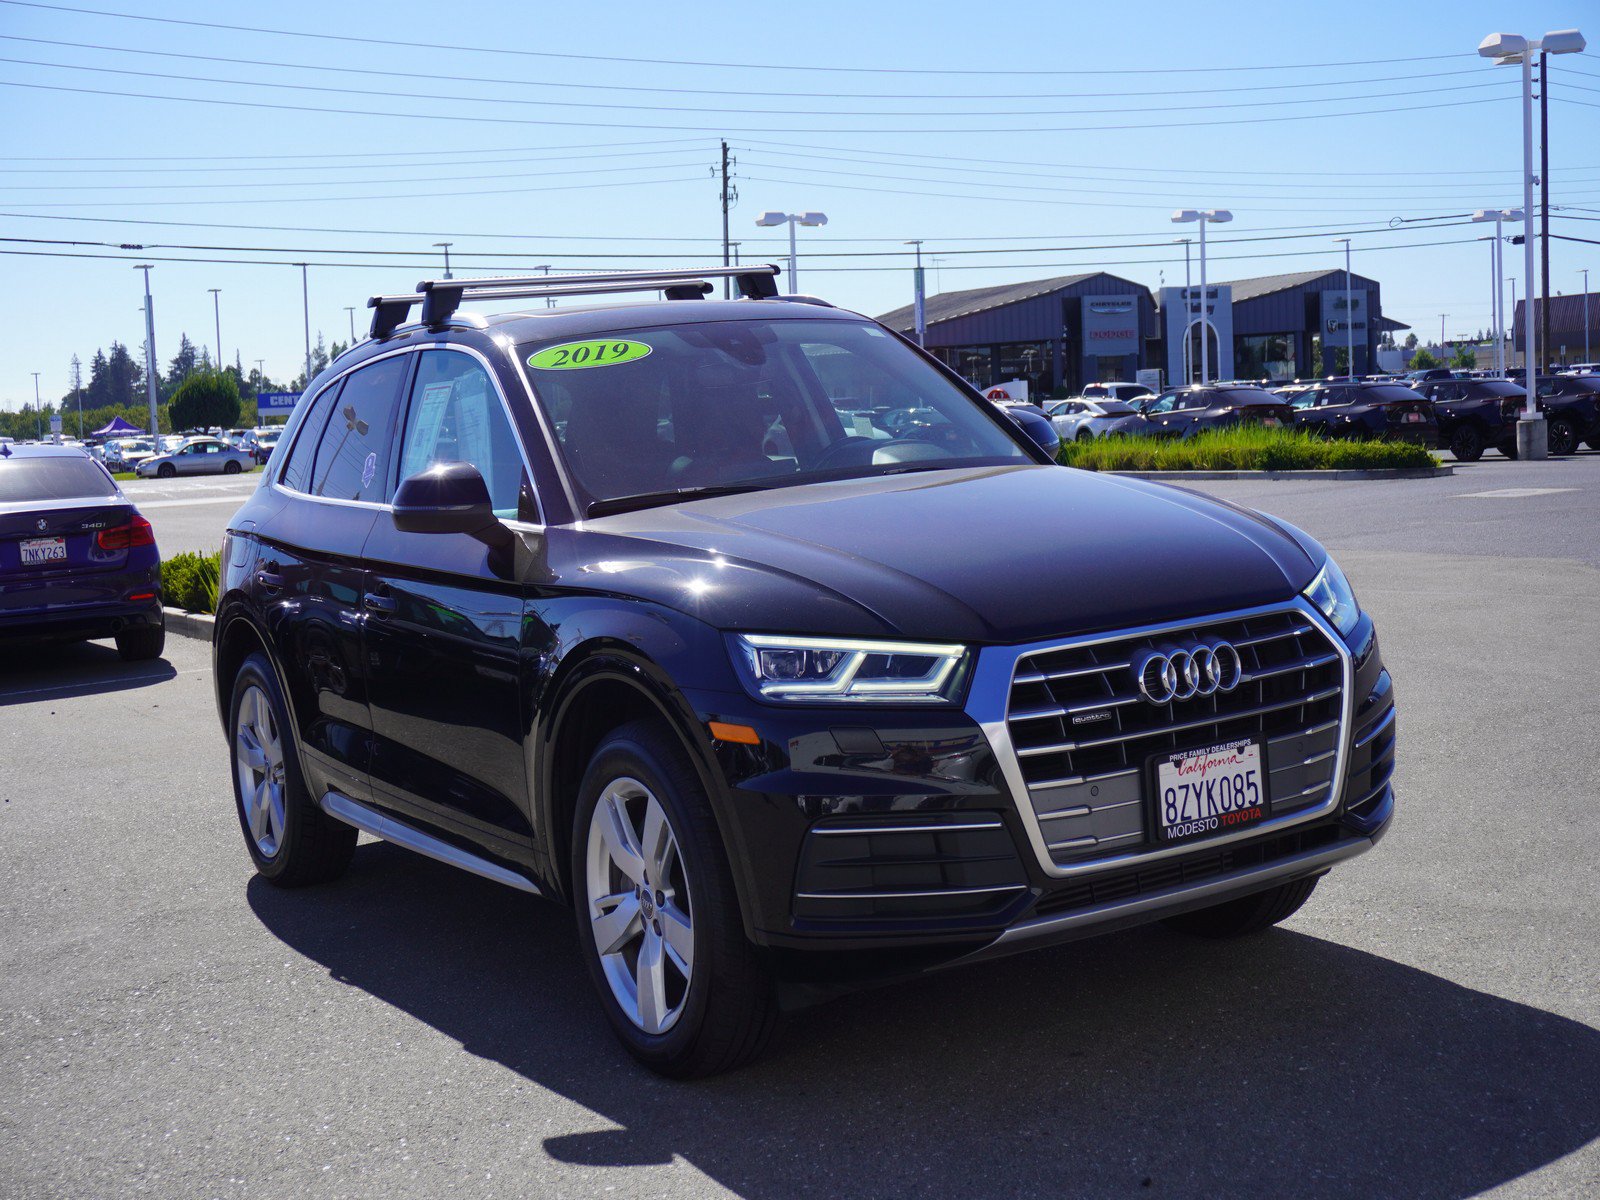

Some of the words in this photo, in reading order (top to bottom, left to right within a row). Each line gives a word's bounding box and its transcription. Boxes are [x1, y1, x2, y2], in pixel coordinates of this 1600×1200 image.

[1333, 296, 1359, 311] Jep
[1090, 330, 1135, 339] DODGE
[551, 343, 629, 367] 2019
[22, 546, 65, 562] 7NKY263
[1074, 712, 1111, 724] quattro
[1169, 752, 1188, 762] PRICE
[1189, 747, 1211, 759] FAMILY
[1211, 739, 1252, 753] DEALERSHIPS
[1178, 752, 1244, 777] California
[1165, 770, 1259, 824] 8ZYK085
[1167, 817, 1218, 839] MODESTO
[1221, 807, 1262, 826] TOYOTA
